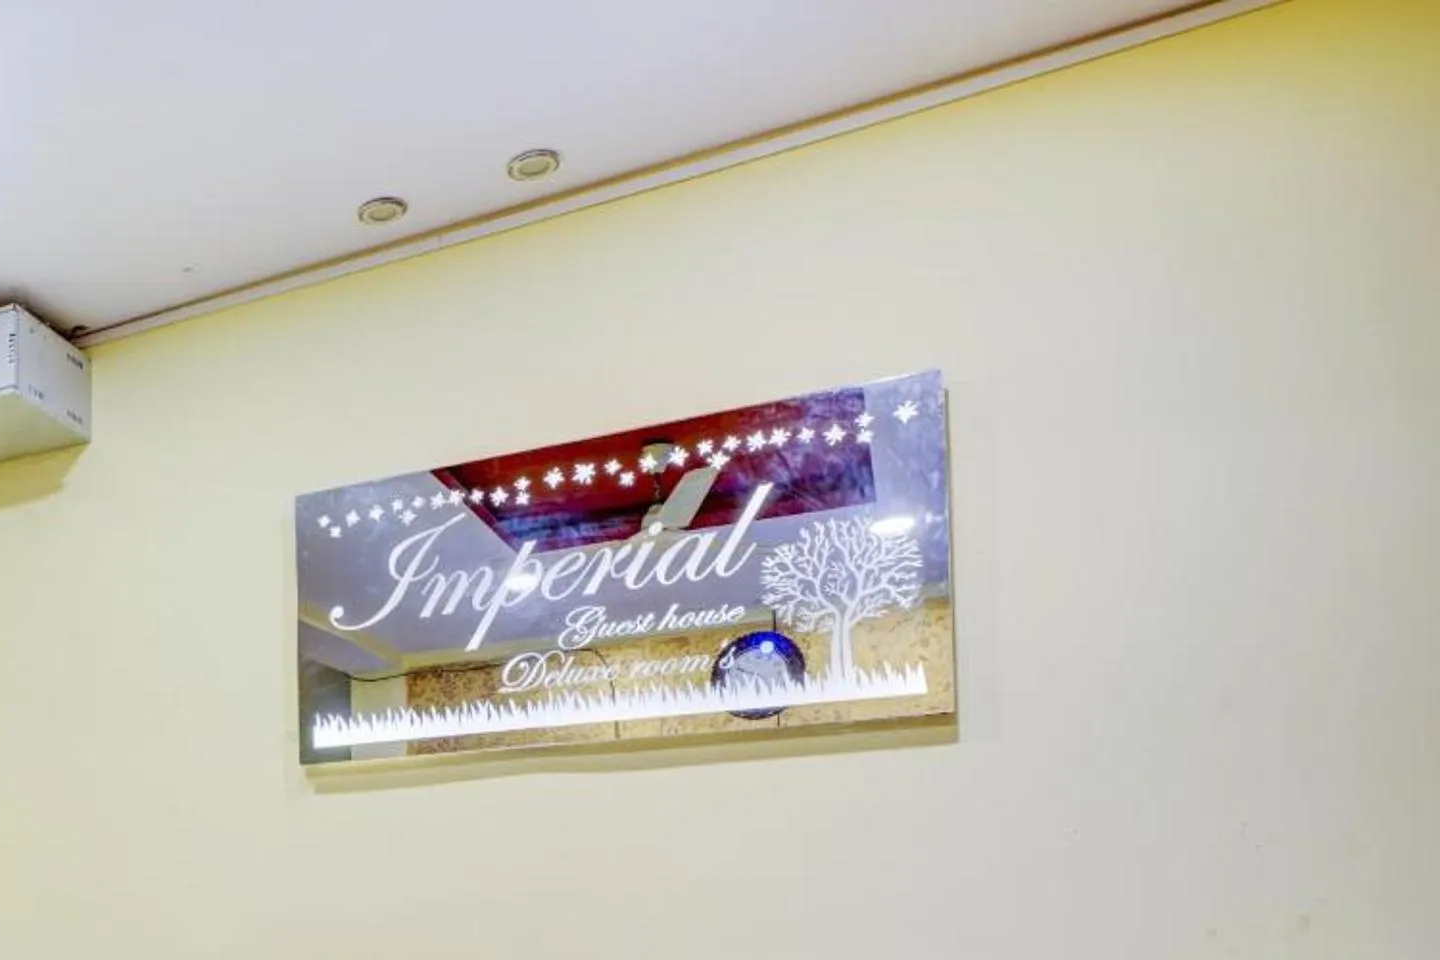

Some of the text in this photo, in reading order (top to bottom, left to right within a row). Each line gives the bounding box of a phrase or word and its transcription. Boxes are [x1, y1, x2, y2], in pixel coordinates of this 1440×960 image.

[329, 482, 774, 652] Imperial
[558, 602, 746, 651] Guest house
[497, 650, 620, 693] Deluxe
